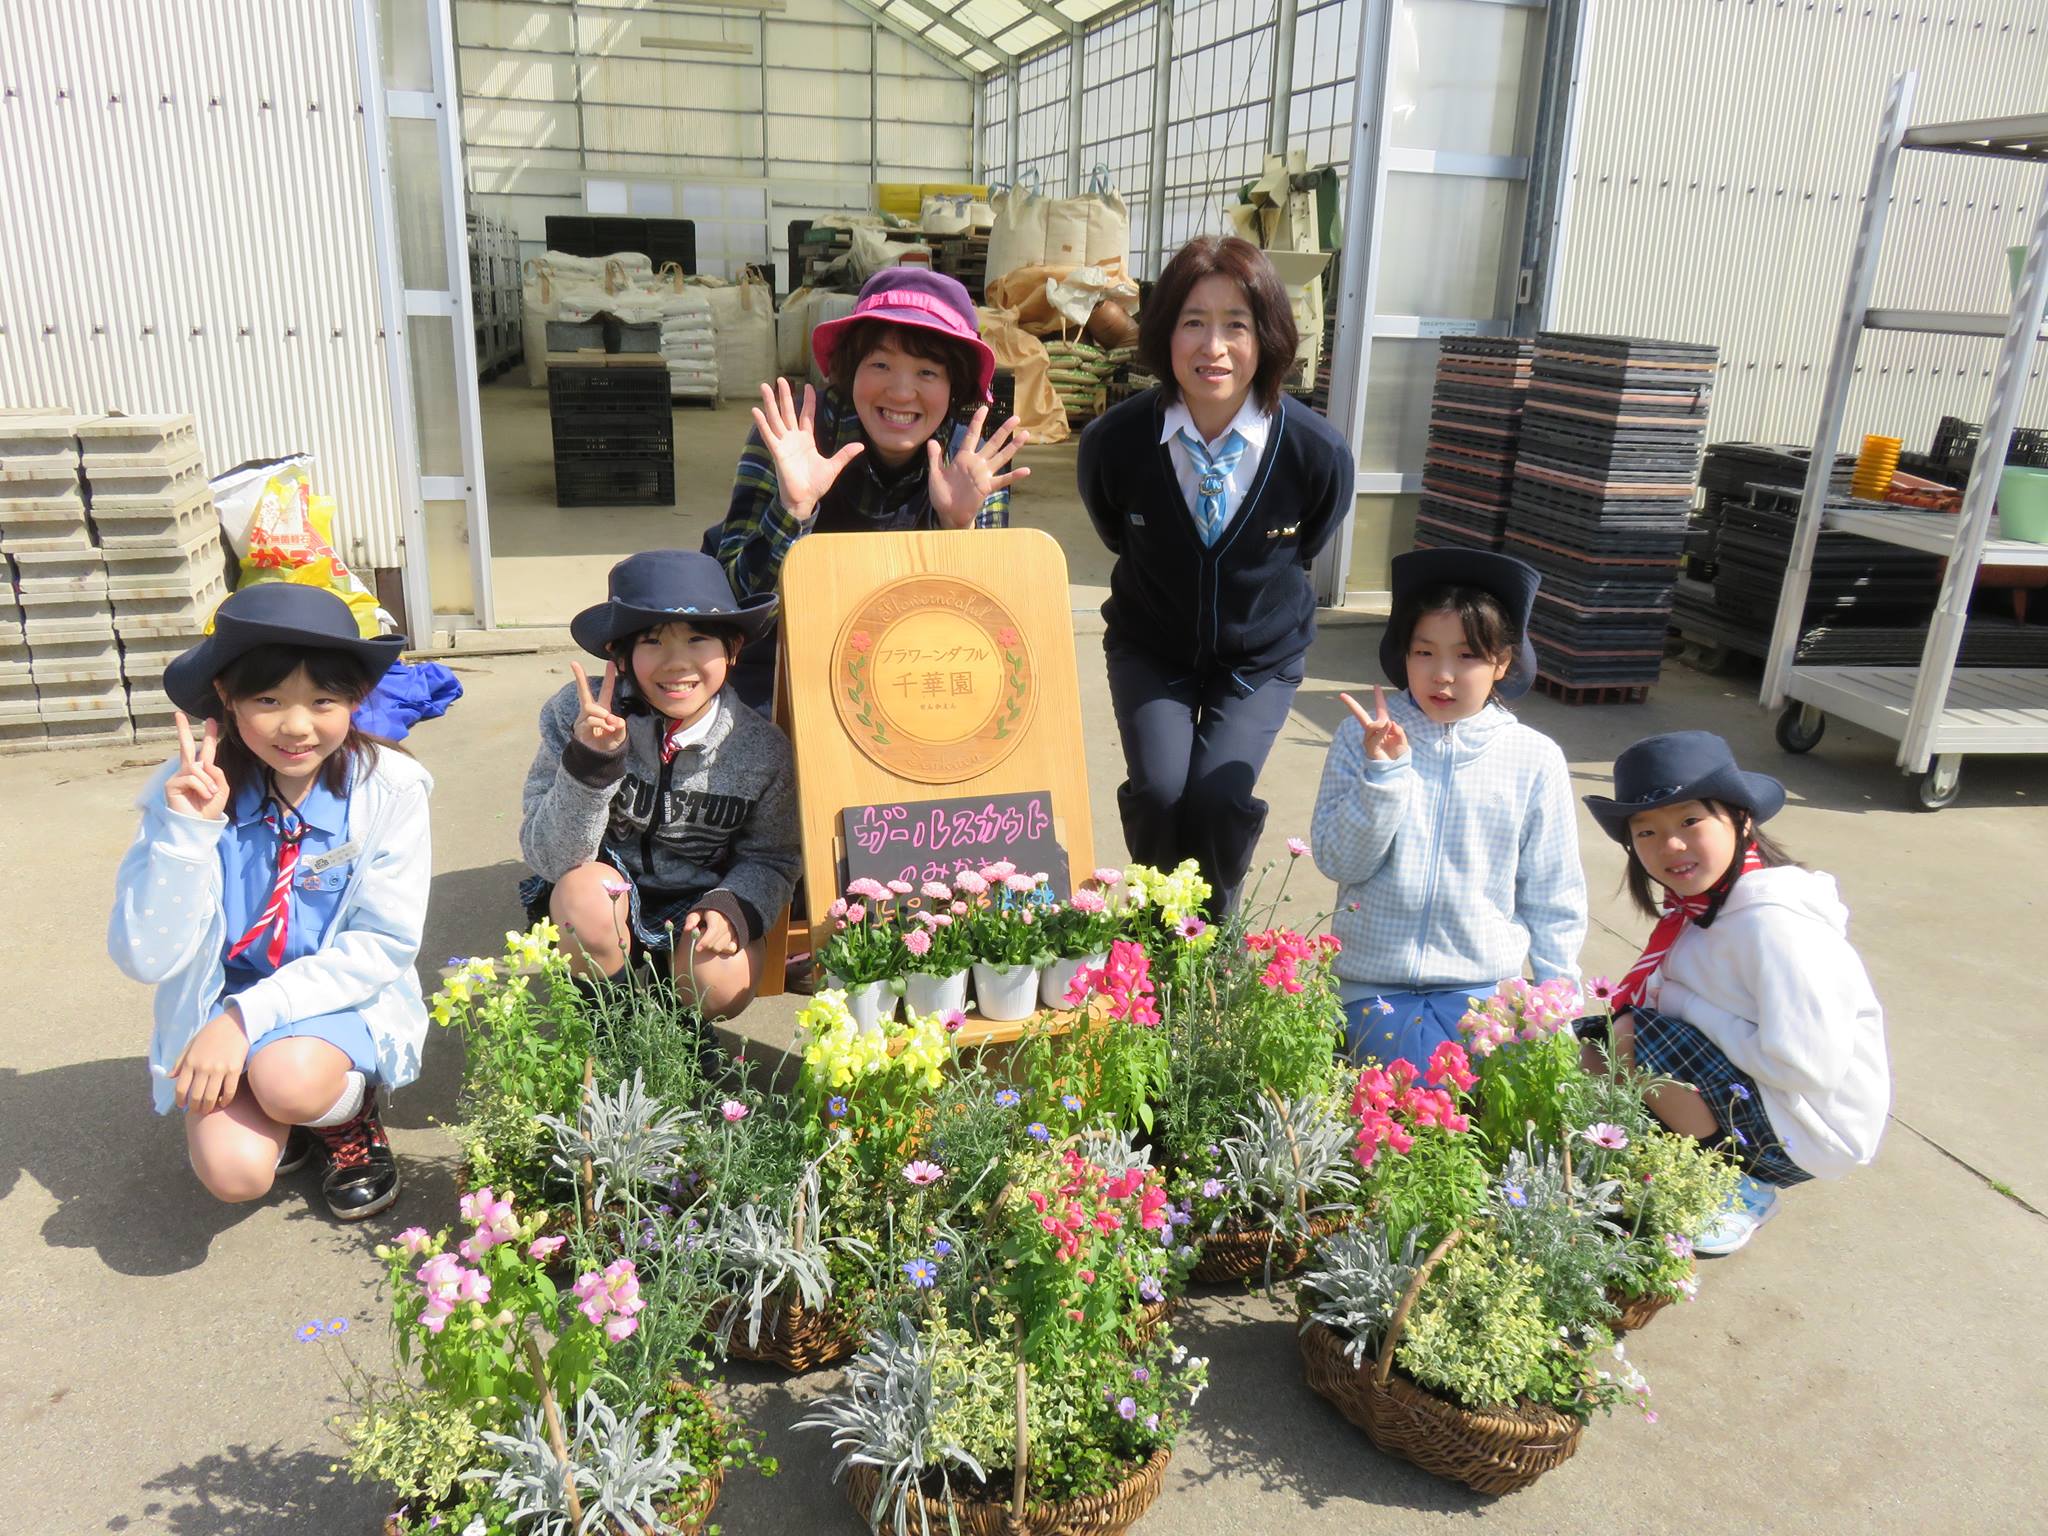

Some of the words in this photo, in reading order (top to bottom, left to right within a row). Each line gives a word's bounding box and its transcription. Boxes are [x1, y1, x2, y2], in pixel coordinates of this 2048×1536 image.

[879, 646, 990, 664] フラワーンダフル
[891, 671, 974, 698] 千華園
[853, 799, 1050, 855] ガールスカウト
